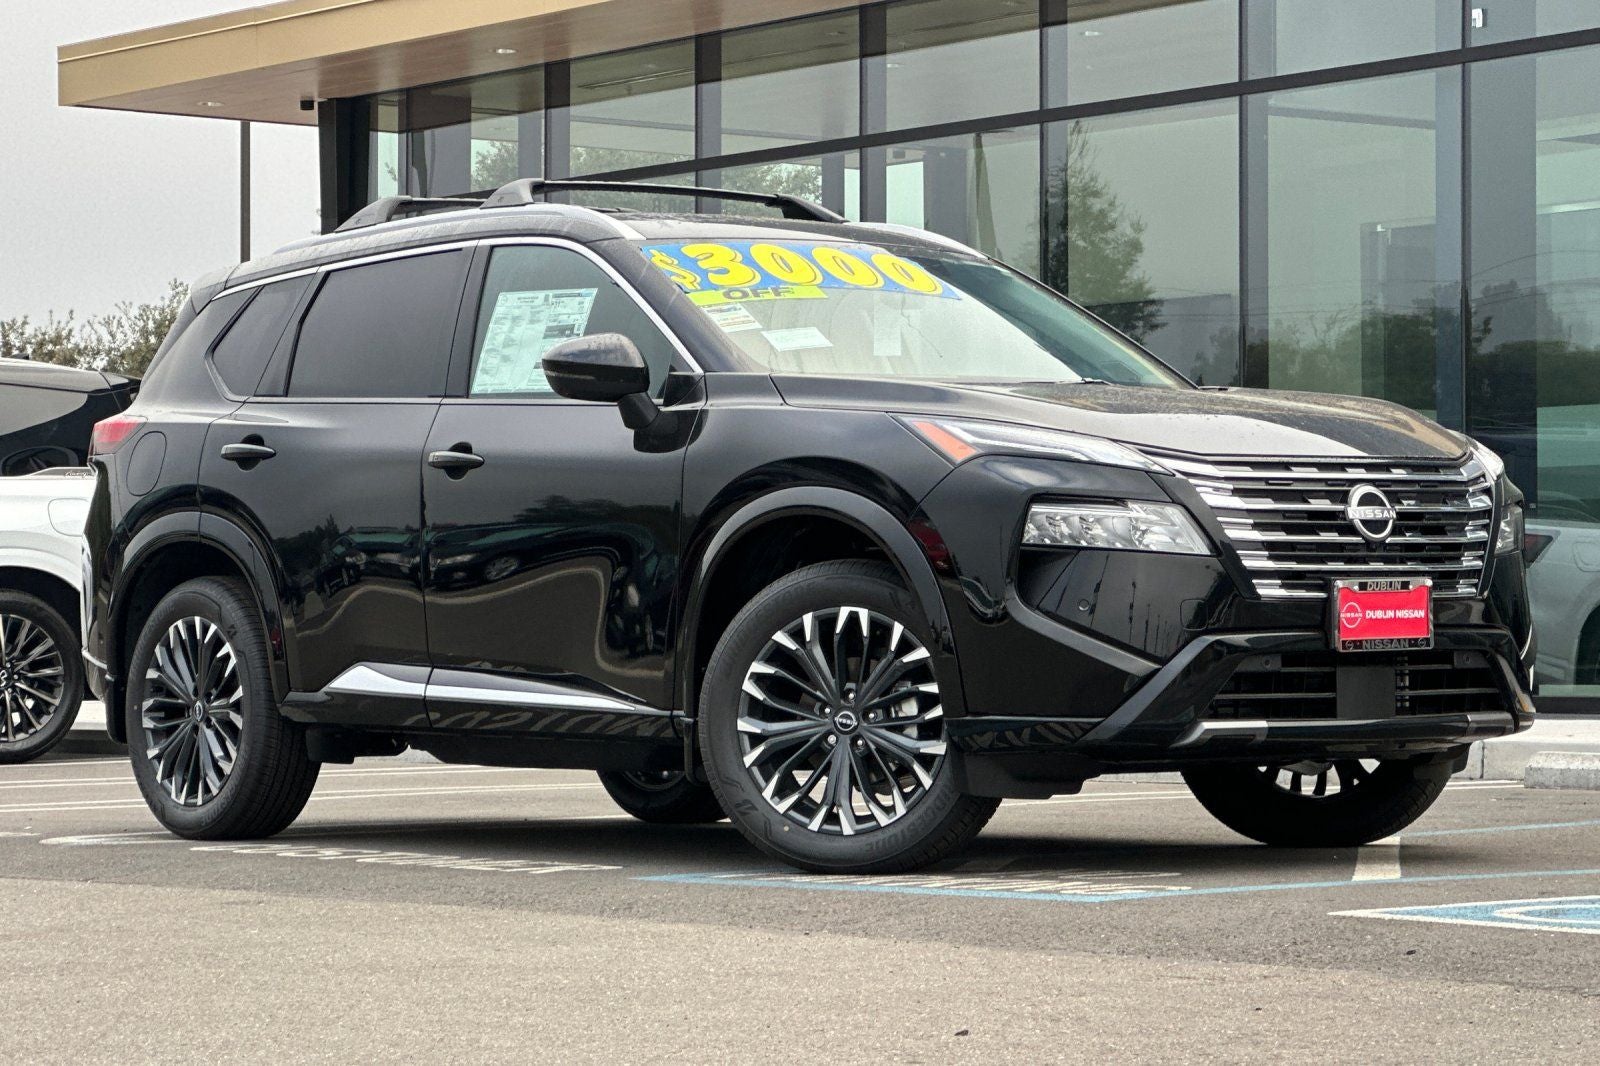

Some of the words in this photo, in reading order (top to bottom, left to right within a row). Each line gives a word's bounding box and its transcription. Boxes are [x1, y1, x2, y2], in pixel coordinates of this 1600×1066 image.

[649, 243, 943, 295] $3000
[722, 287, 795, 300] OFF
[1348, 508, 1397, 519] NISSAN
[1367, 580, 1402, 591] DUBLIN
[1365, 610, 1395, 619] DUBLIN
[1396, 609, 1425, 619] NISSAN
[1361, 639, 1409, 650] NISSAN
[189, 843, 623, 874] CUSTOMER
